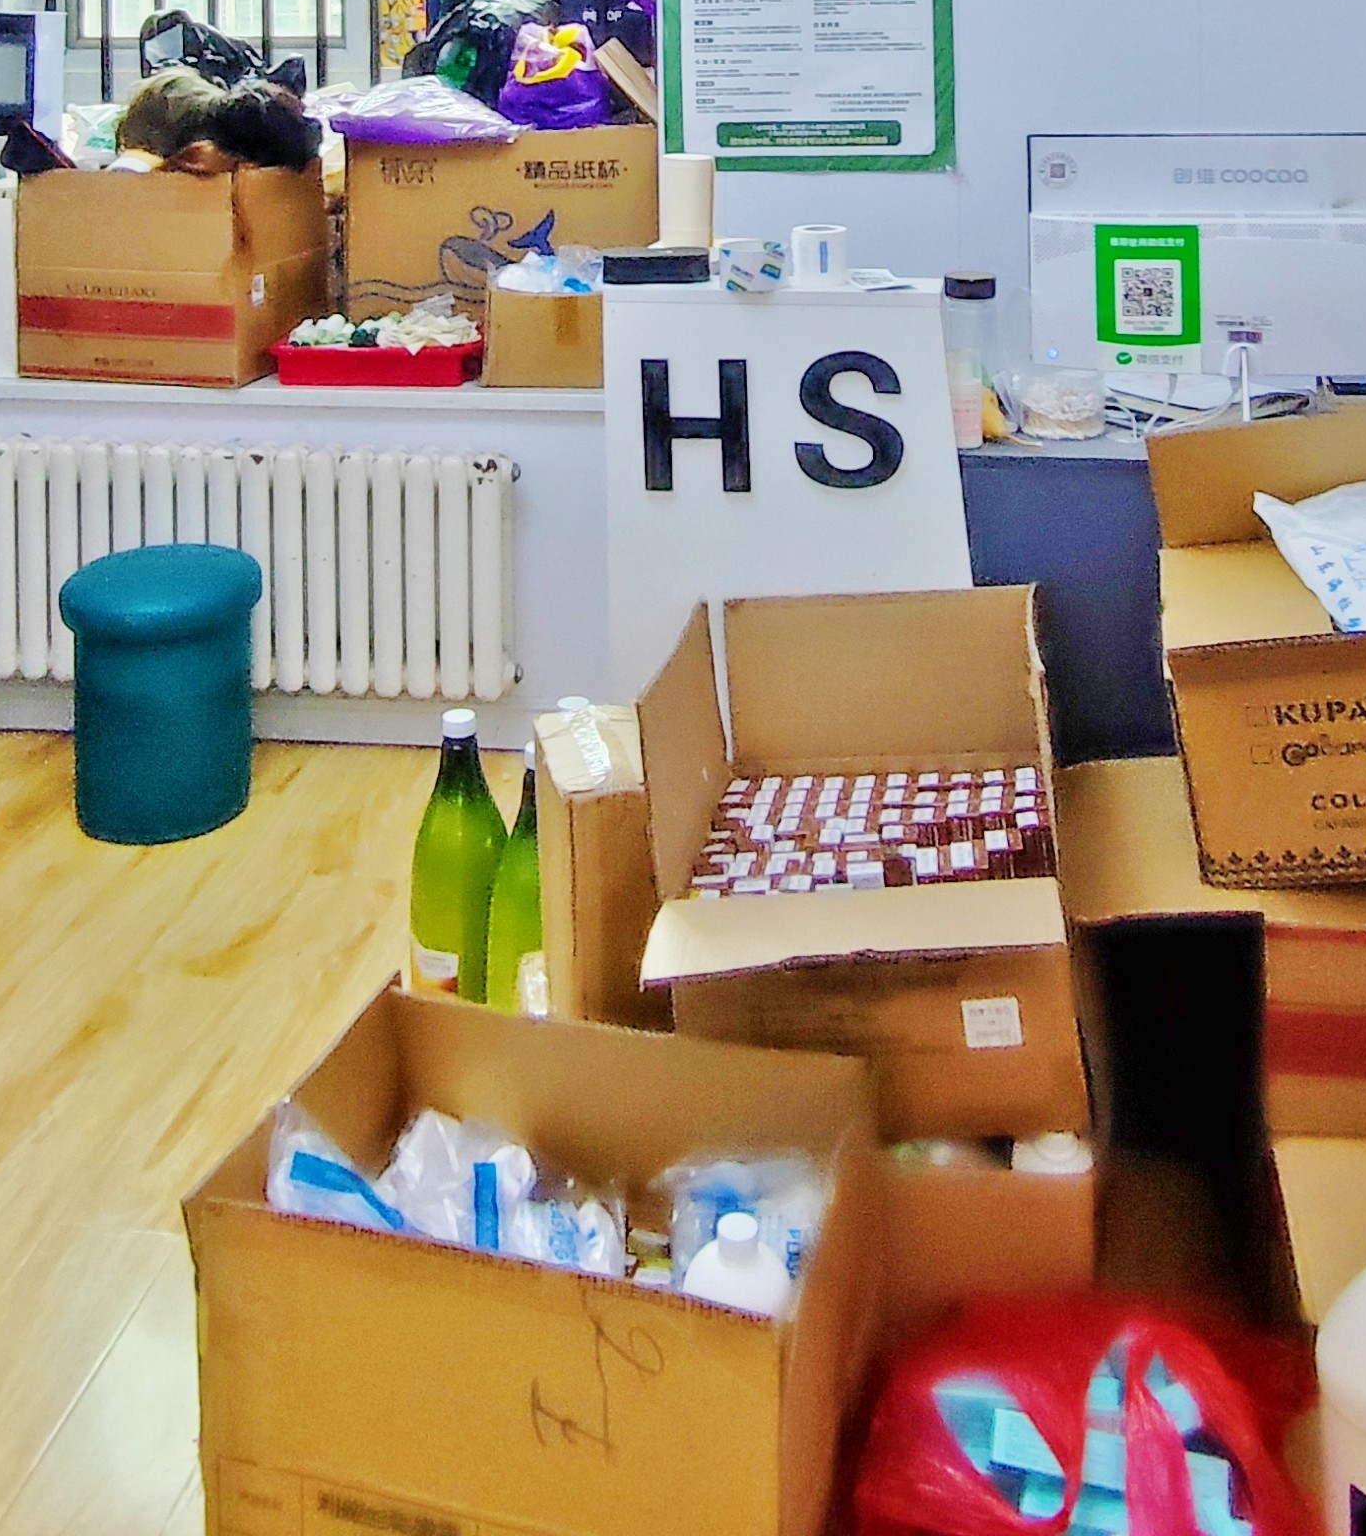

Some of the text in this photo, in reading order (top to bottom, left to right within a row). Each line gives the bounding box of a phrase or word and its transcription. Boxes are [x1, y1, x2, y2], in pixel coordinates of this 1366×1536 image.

[523, 160, 621, 181] 精品纸杯
[1173, 167, 1216, 184] 创维
